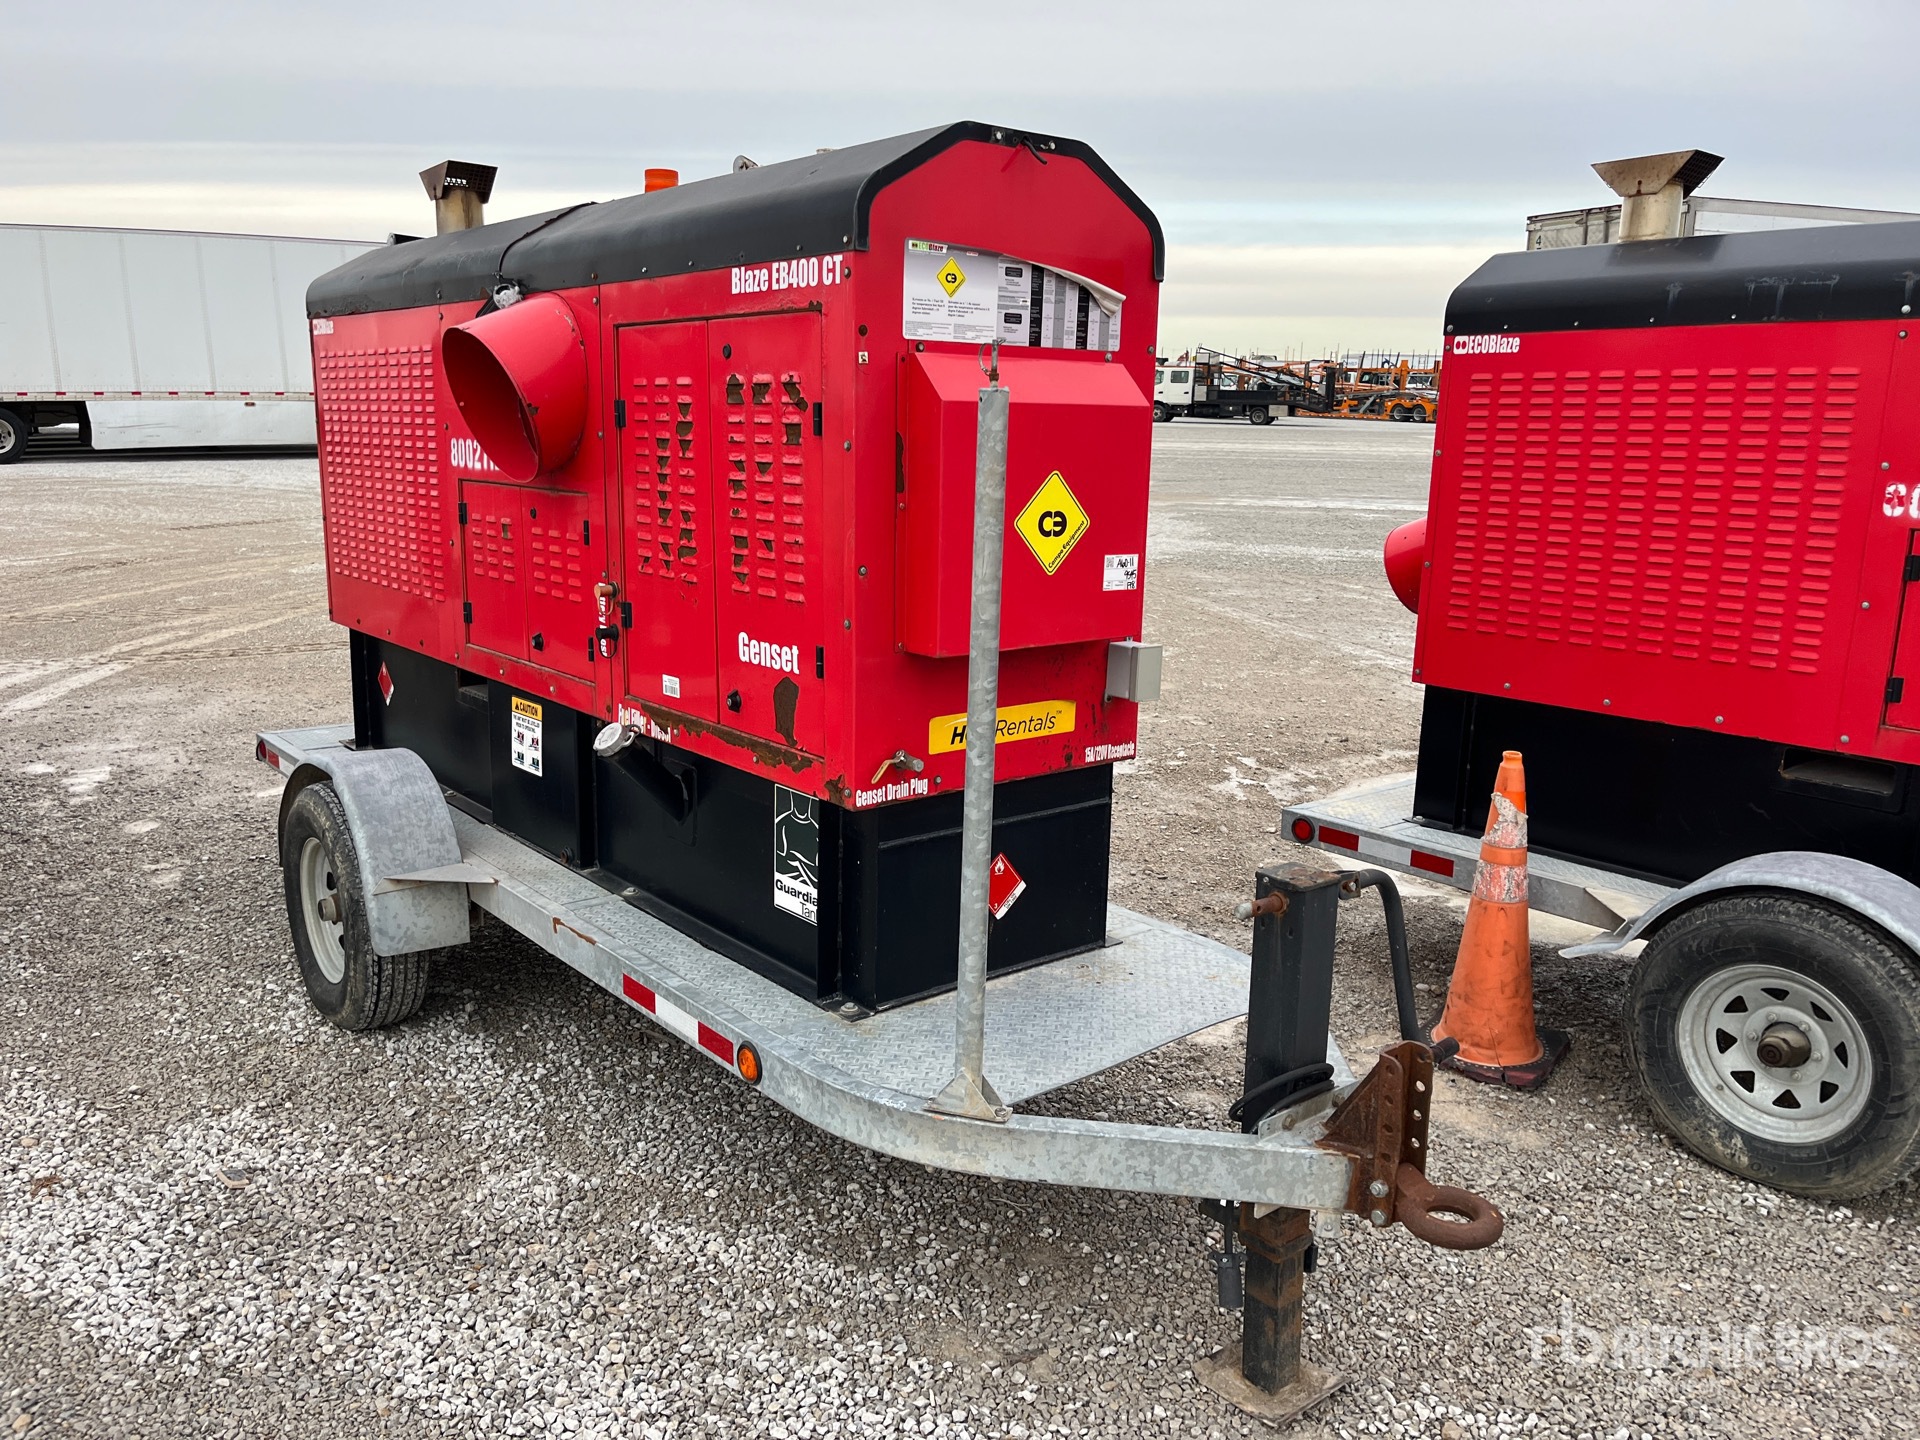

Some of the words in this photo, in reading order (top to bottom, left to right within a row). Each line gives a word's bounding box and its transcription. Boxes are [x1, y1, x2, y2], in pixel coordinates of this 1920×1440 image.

[731, 267, 769, 295] Blaze
[771, 257, 819, 290] EB400
[822, 254, 843, 286] CT
[1467, 334, 1520, 354] ECOBlaze
[1048, 548, 1064, 568] Campo
[1062, 520, 1085, 551] Equipment
[738, 631, 800, 675] Genset
[519, 702, 538, 717] CAUTION
[1107, 741, 1135, 759] Receptacle
[855, 786, 886, 807] Genset
[887, 781, 909, 801] Drain
[910, 777, 929, 795] Plug
[775, 878, 818, 907] Guardia
